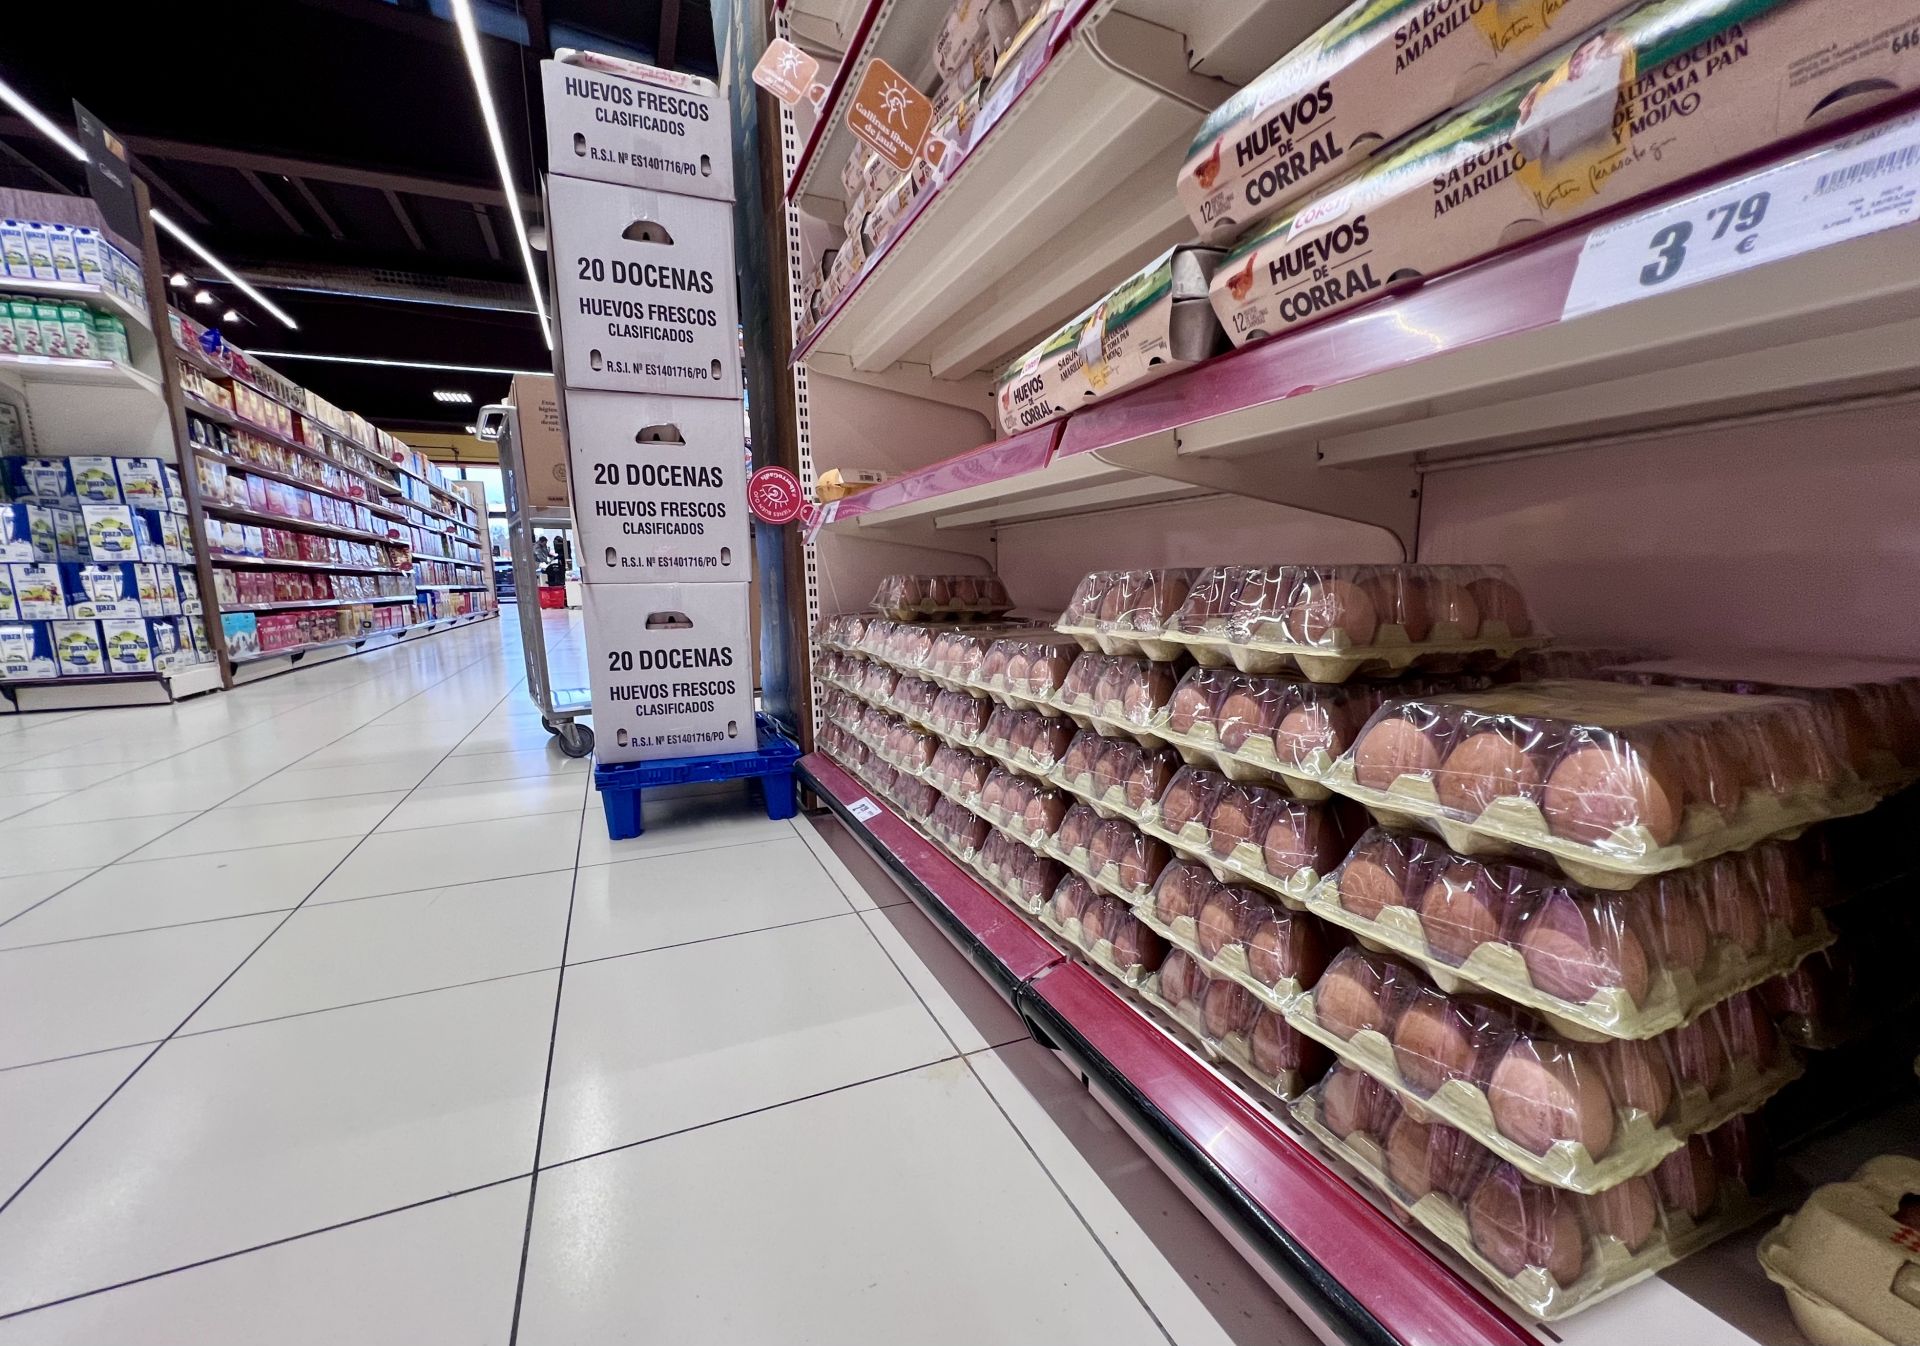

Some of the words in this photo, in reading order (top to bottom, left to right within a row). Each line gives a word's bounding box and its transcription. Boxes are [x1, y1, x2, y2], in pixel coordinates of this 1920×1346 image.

[1394, 0, 1463, 49] SABO
[1395, 0, 1484, 75] AMARILLO
[1616, 73, 1656, 107] ALTA
[1662, 24, 1743, 79] COCINA
[565, 76, 633, 106] HUEVOS
[638, 90, 710, 122] FRESCOS
[1612, 104, 1634, 129] DE
[1642, 69, 1699, 112] TOMA
[1707, 39, 1748, 77] PAN
[595, 107, 685, 137] CLASIFICADOS
[855, 102, 891, 136] Gallinas
[890, 130, 914, 155] libres
[1236, 80, 1333, 168] HUEVOS
[1612, 127, 1623, 144] Y
[864, 124, 876, 136] de
[875, 130, 897, 154] jaula
[1278, 138, 1295, 158] DE
[590, 147, 616, 163] R.S.I.
[631, 153, 696, 176] ES1401716/PO
[1245, 131, 1344, 207] CORRAL
[1433, 138, 1513, 195] SABOR
[1434, 150, 1527, 219] AMARILLO
[1200, 201, 1214, 224] 12
[1269, 214, 1370, 286] HUEVOS
[1639, 220, 1693, 287] 3
[1733, 233, 1759, 254] €
[577, 257, 605, 282] 20
[611, 260, 714, 294] DOCENAS
[1313, 265, 1329, 283] DE
[1279, 263, 1382, 323] CORRAL
[579, 297, 644, 320] HUEVOS
[648, 303, 717, 327] FRESCOS
[1232, 312, 1247, 333] 12
[608, 323, 694, 343] CLASIFICADOS
[607, 361, 631, 374] R.S.I.
[645, 364, 707, 379] ES1401716/PO
[1013, 374, 1044, 404] HUEVOS
[1020, 400, 1053, 427] CORRAL
[593, 463, 620, 485] 20
[626, 463, 723, 488] DOCENAS
[595, 501, 657, 517] HUEVOS
[661, 501, 726, 518] FRESCOS
[622, 522, 704, 535] CLASIFICADOS
[621, 556, 644, 567] R.S.I.
[658, 556, 717, 567] ES1401716/PO
[608, 650, 633, 671] 20
[639, 647, 733, 670] DOCENAS
[610, 683, 668, 701] HUEVOS
[672, 680, 736, 697] FRESCOS
[636, 700, 715, 716] CLASIFICADOS
[631, 737, 654, 747] R.S.I.
[667, 731, 724, 745] ES1401716/PO
